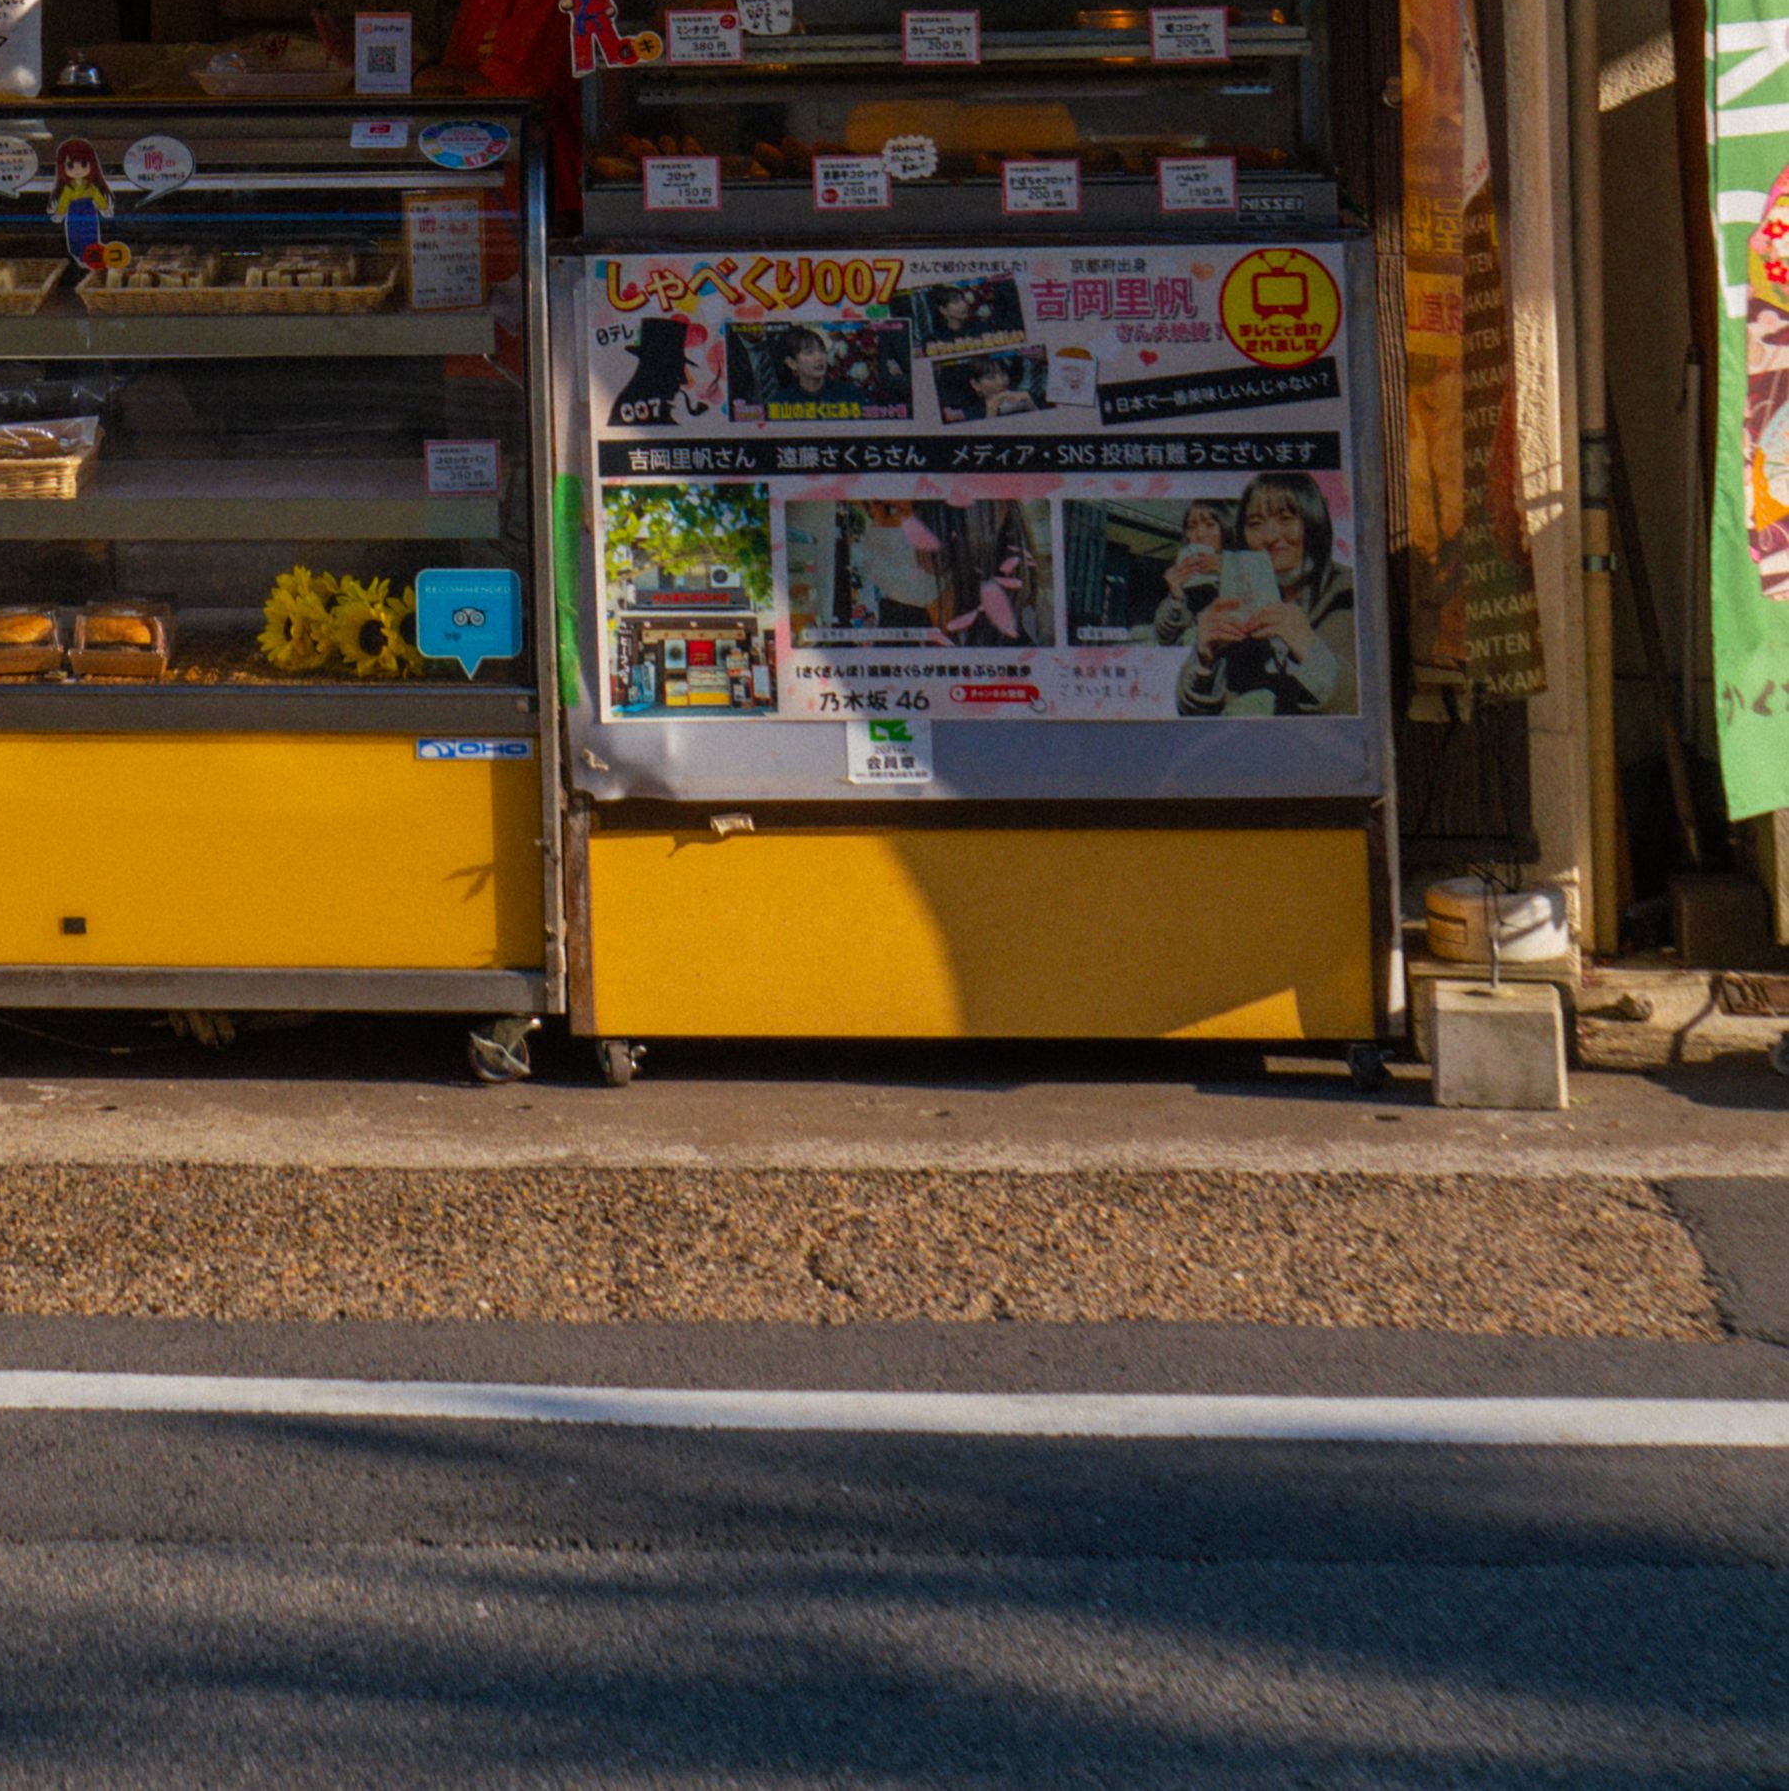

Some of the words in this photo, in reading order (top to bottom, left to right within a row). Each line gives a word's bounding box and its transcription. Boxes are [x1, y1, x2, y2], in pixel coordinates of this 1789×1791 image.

[910, 25, 972, 36] カレーコロッケ
[927, 41, 951, 51] 200
[1176, 38, 1199, 48] 200
[667, 172, 697, 181] コロッケ
[678, 187, 699, 197] 150
[843, 186, 866, 196] 250
[1028, 189, 1051, 199] 200
[1070, 258, 1147, 274] 京都府出身
[605, 256, 904, 312] しゃべくり007
[1030, 277, 1198, 321] 吉岡里帆
[629, 446, 756, 470] 吉岡里帆さん
[777, 445, 926, 469] 遠藤さくらさん
[952, 442, 1095, 467] メディア・SNS
[1101, 440, 1316, 466] 投稿有難うございます
[818, 690, 890, 713] 乃木坂
[895, 689, 930, 711] 46
